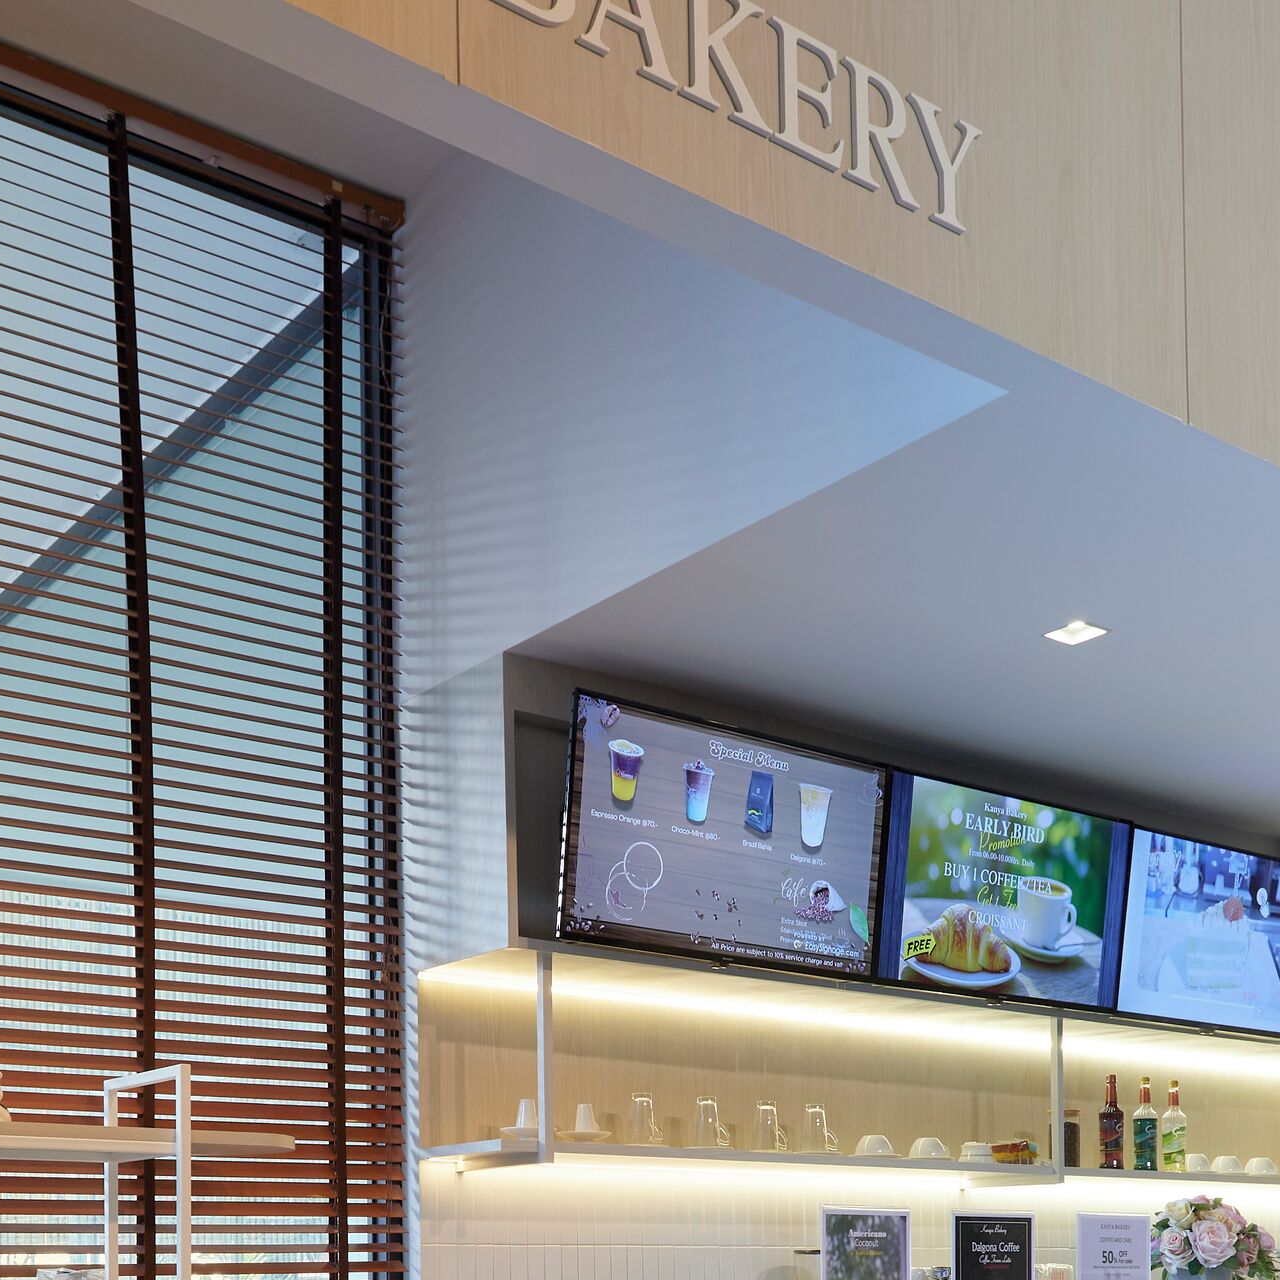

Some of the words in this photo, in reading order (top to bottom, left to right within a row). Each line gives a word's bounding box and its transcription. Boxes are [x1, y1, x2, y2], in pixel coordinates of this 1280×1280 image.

[488, 0, 982, 236] AKERY
[709, 740, 754, 763] Special
[755, 752, 789, 771] Menu
[590, 808, 618, 821] Espresso
[619, 814, 640, 826] Orange
[984, 802, 1005, 815] Kanya
[1006, 808, 1027, 822] Bakery
[671, 825, 704, 838] Choco-Mint
[965, 812, 1011, 837] EARLY
[1013, 822, 1045, 844] BIRD
[742, 839, 757, 848] Brazil
[979, 830, 1026, 852] Promotion
[790, 853, 811, 864] Dalgona
[1022, 858, 1035, 869] Daily
[944, 862, 970, 879] BUY
[973, 867, 977, 881] 1
[980, 868, 1025, 890] COFFEE
[976, 885, 993, 909] Get
[781, 917, 794, 926] Extra
[795, 919, 808, 927] Shot
[968, 910, 1028, 931] CROISSANT
[711, 942, 719, 950] All
[720, 944, 735, 952] Price
[746, 947, 766, 958] subject
[774, 951, 784, 960] 10%
[785, 954, 804, 963] service
[805, 957, 823, 967] charge
[823, 959, 833, 967] and
[805, 941, 860, 958] EasySignage.com
[907, 938, 931, 956] FREE
[848, 1229, 887, 1238] Americano
[854, 1238, 879, 1248] Coconut
[971, 1241, 997, 1253] Dalgona
[998, 1241, 1020, 1252] Coffee
[1102, 1250, 1118, 1264] 50%
